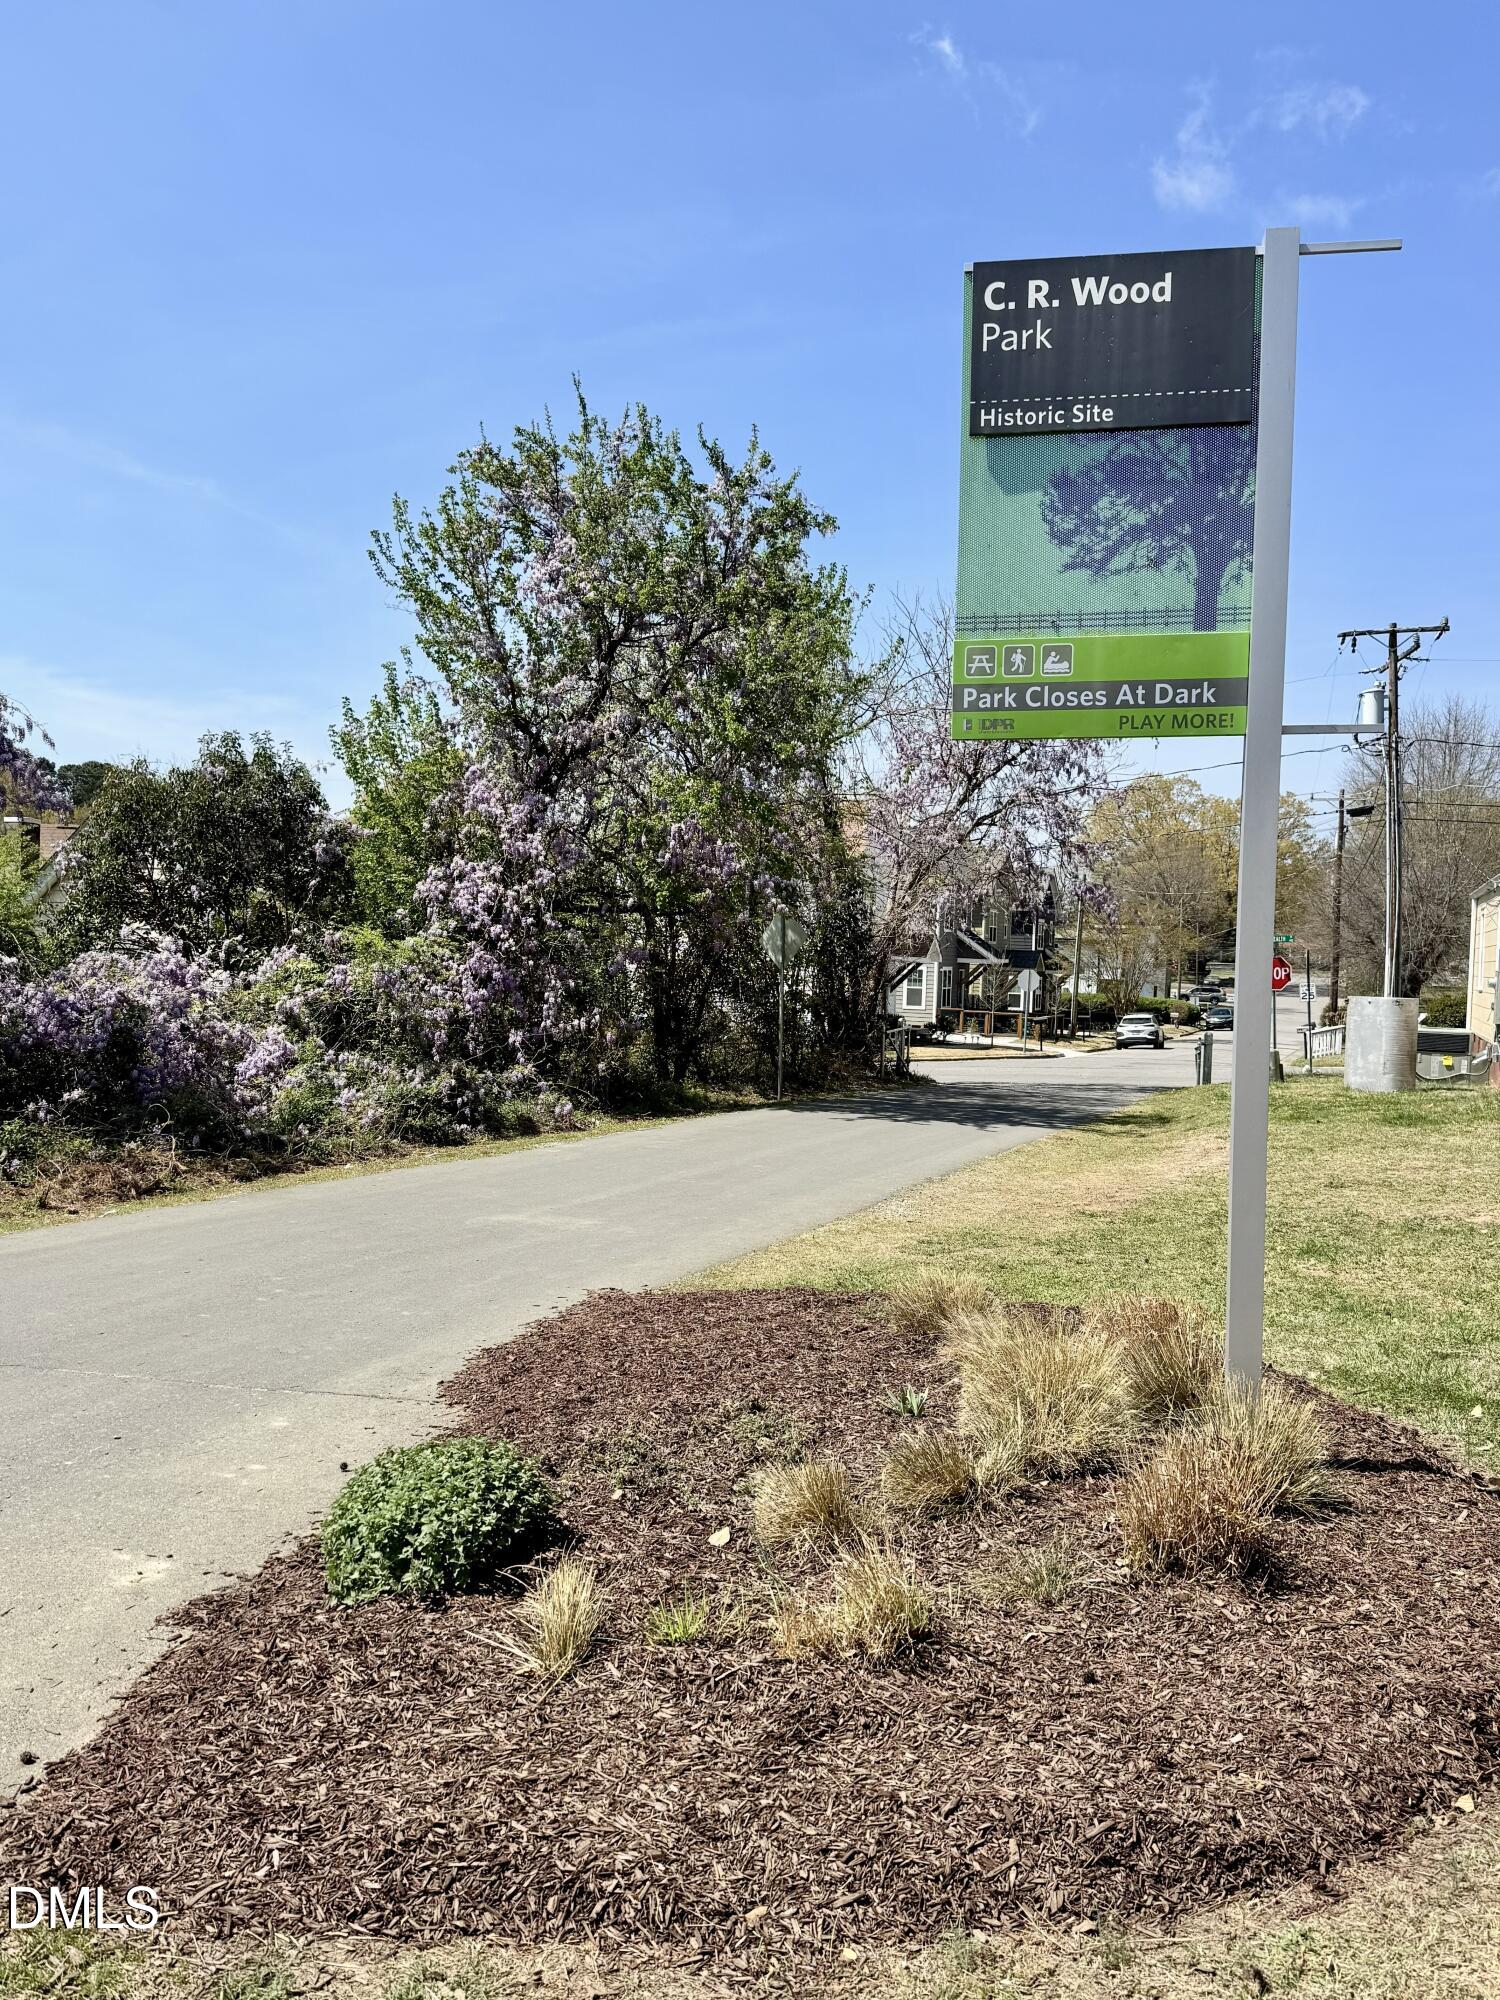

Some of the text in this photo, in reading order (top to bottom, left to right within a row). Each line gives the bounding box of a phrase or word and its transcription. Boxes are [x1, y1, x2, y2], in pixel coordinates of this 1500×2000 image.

[983, 271, 1172, 311] C. R. Wood
[982, 319, 1053, 352] Park
[979, 403, 1114, 427] Historic Site
[963, 681, 1216, 709] Park Closes At Dark
[1119, 713, 1234, 731] PLAY MORE!
[1273, 967, 1289, 980] OP
[1301, 991, 1315, 1000] 25
